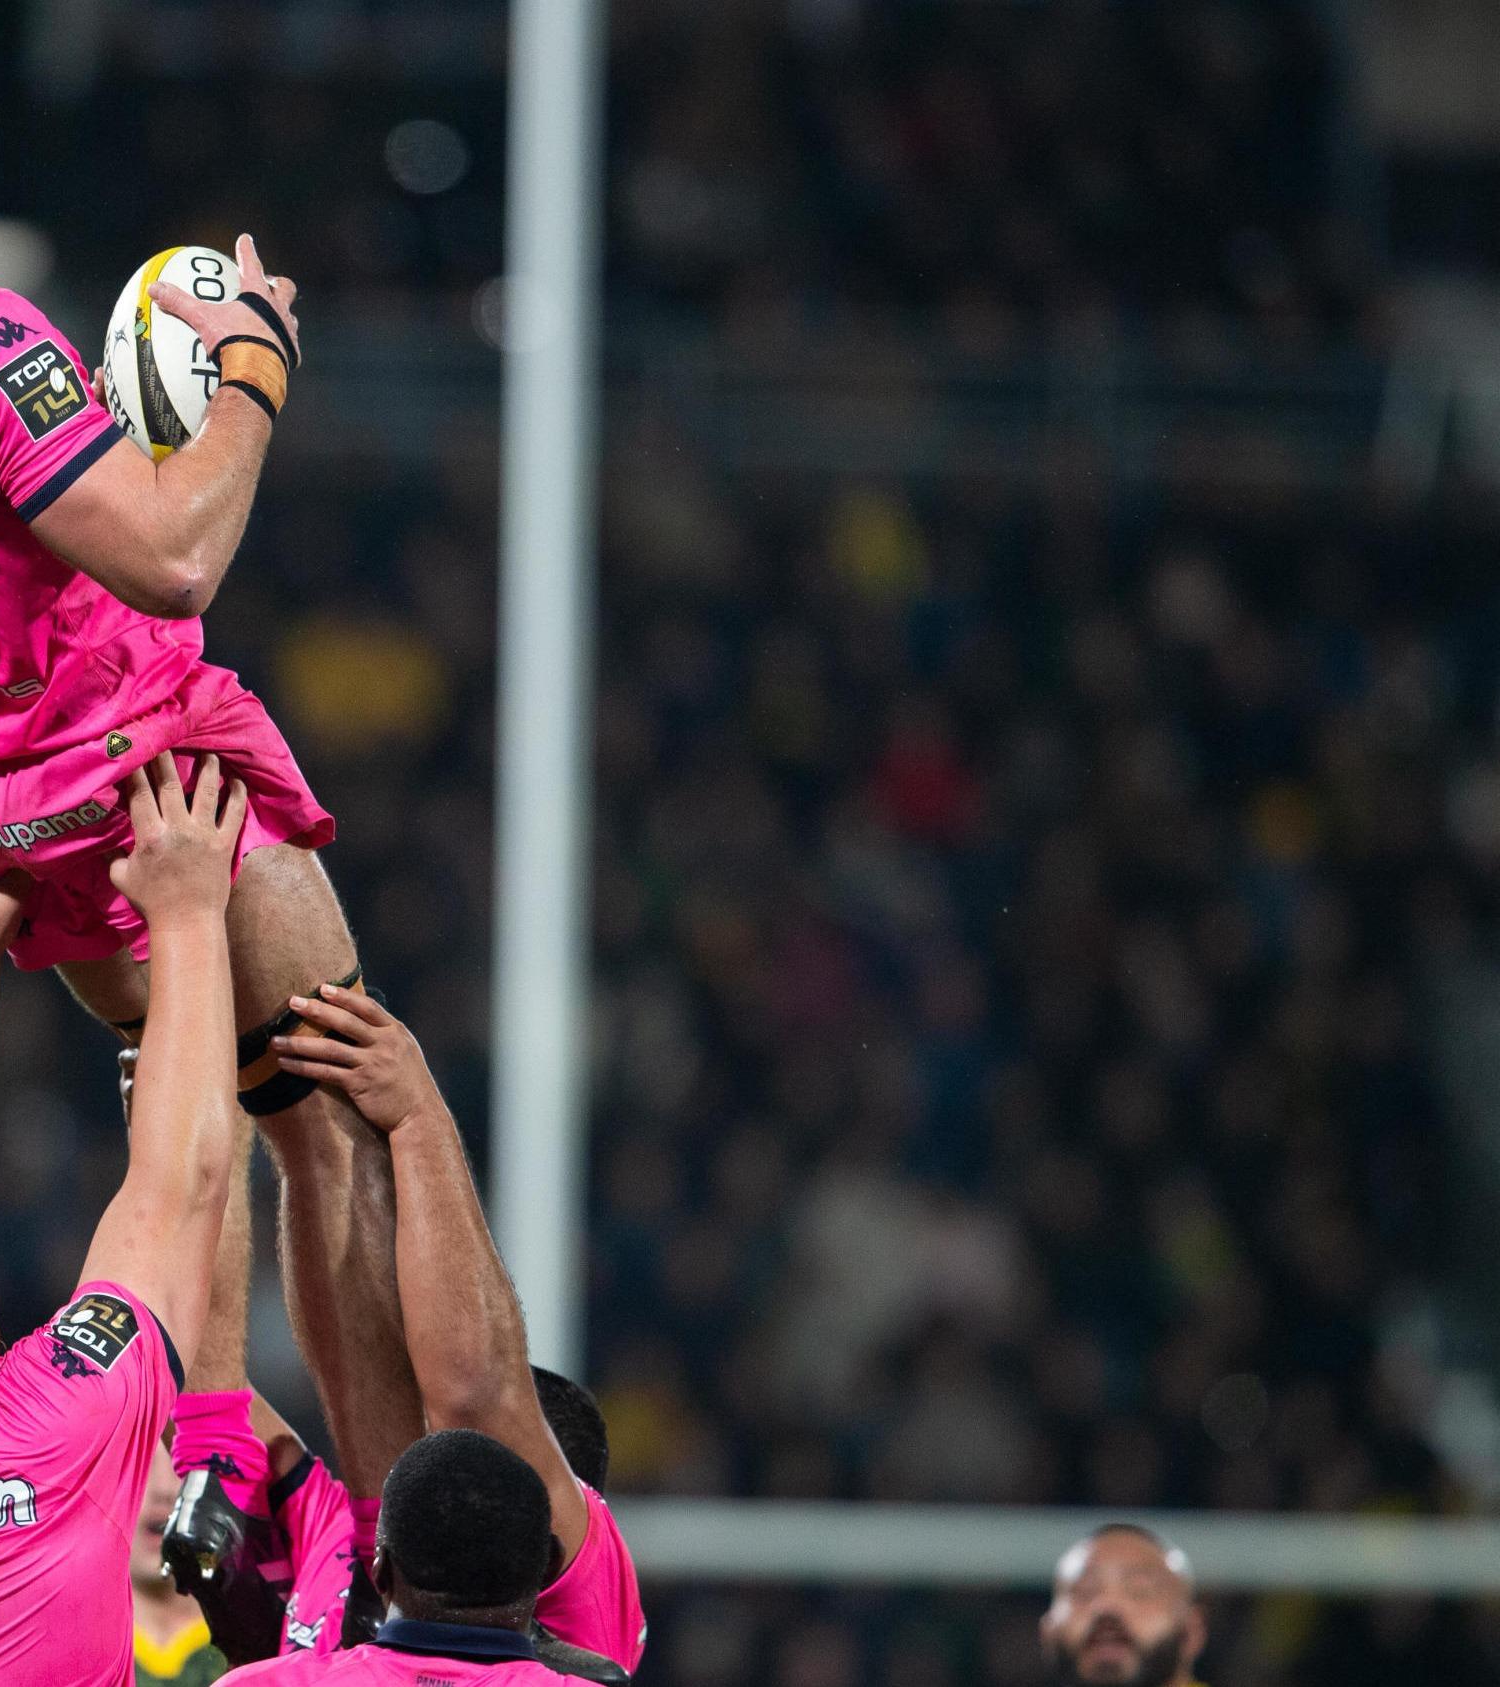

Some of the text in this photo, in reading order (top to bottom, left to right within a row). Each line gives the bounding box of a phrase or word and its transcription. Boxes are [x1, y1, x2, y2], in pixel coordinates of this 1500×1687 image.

[6, 351, 57, 388] TOP
[31, 379, 80, 425] 14
[76, 1298, 130, 1329] 14
[57, 1325, 108, 1357] TOP
